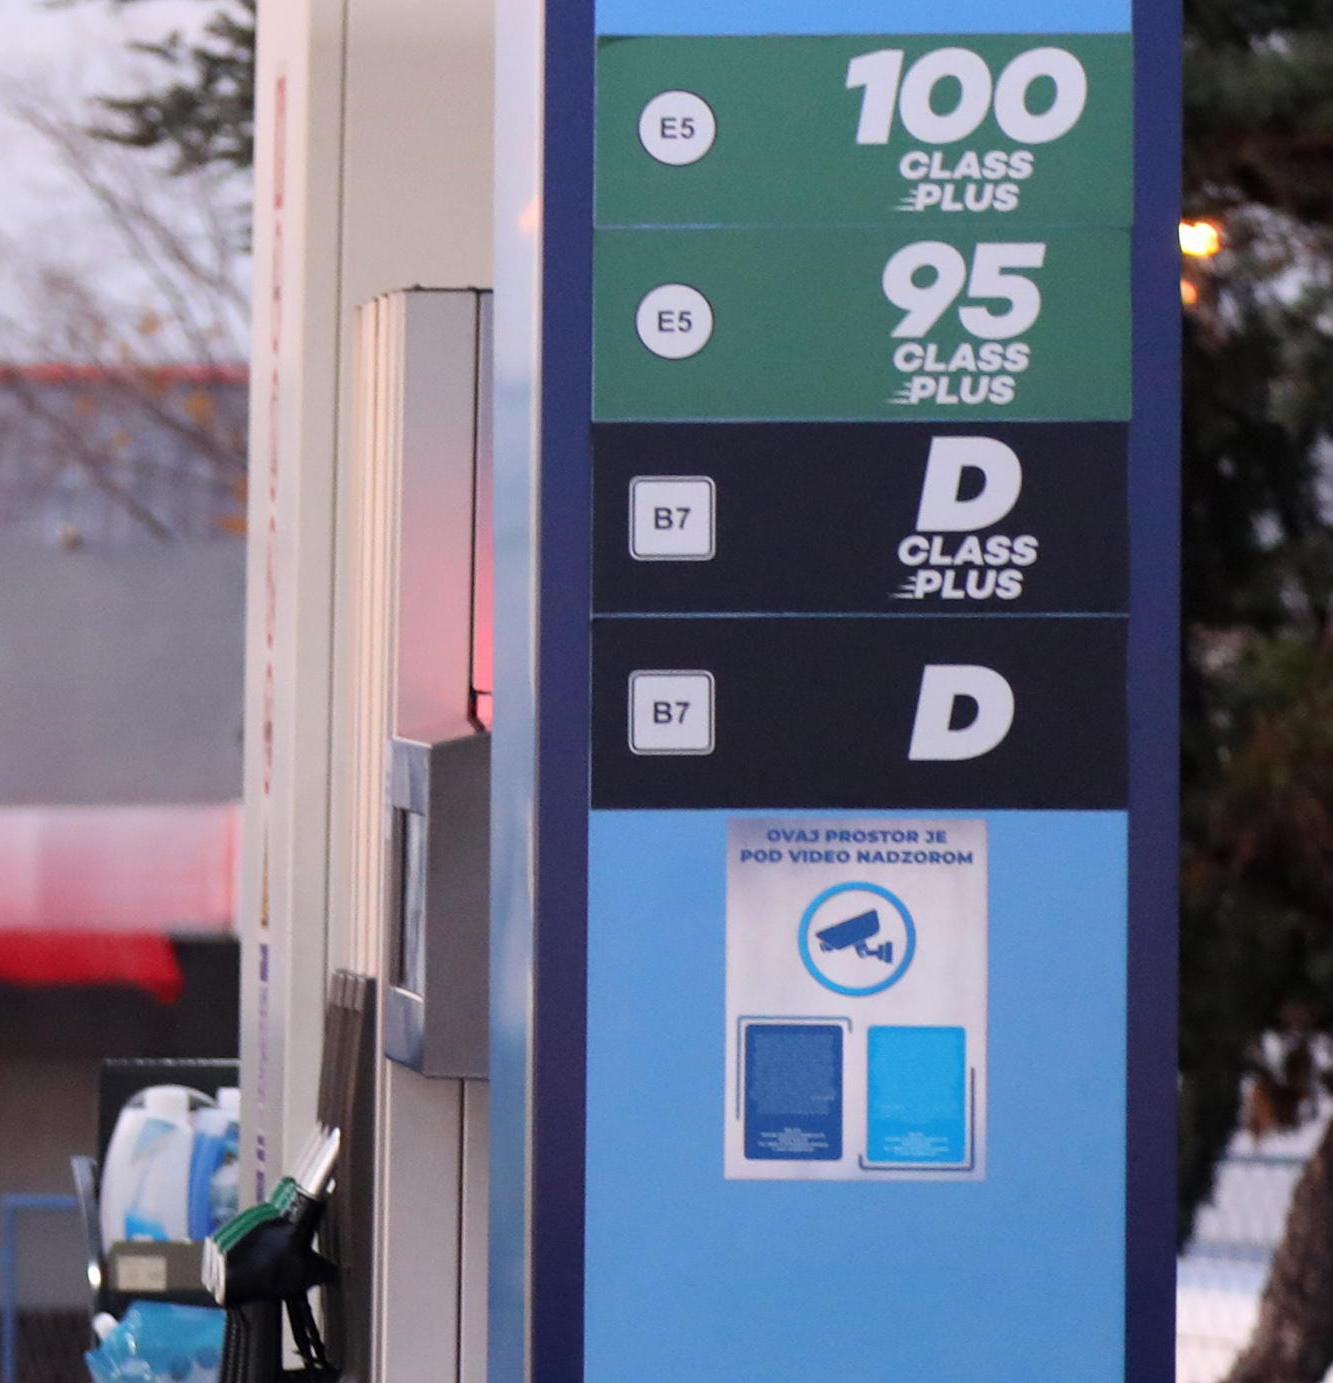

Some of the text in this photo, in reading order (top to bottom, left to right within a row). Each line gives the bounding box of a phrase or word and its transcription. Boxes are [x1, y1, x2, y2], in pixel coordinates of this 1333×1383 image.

[845, 46, 1088, 145] 100
[660, 117, 695, 140] E5
[899, 150, 1034, 180] CLASS
[911, 183, 1020, 212] PLUS
[882, 240, 1047, 340] 95
[657, 310, 693, 333] E5
[893, 343, 1031, 373] CLASS
[907, 375, 1016, 405] PLUS
[915, 436, 1023, 532] D
[654, 507, 691, 530] B7
[898, 535, 1039, 566] CLASS
[913, 568, 1024, 600] PLUS
[653, 701, 690, 724] B7
[908, 664, 1015, 761] D
[766, 828, 948, 844] OVAJ PROSTOR JE
[739, 848, 974, 865] POD VIDEO NADZOROM
